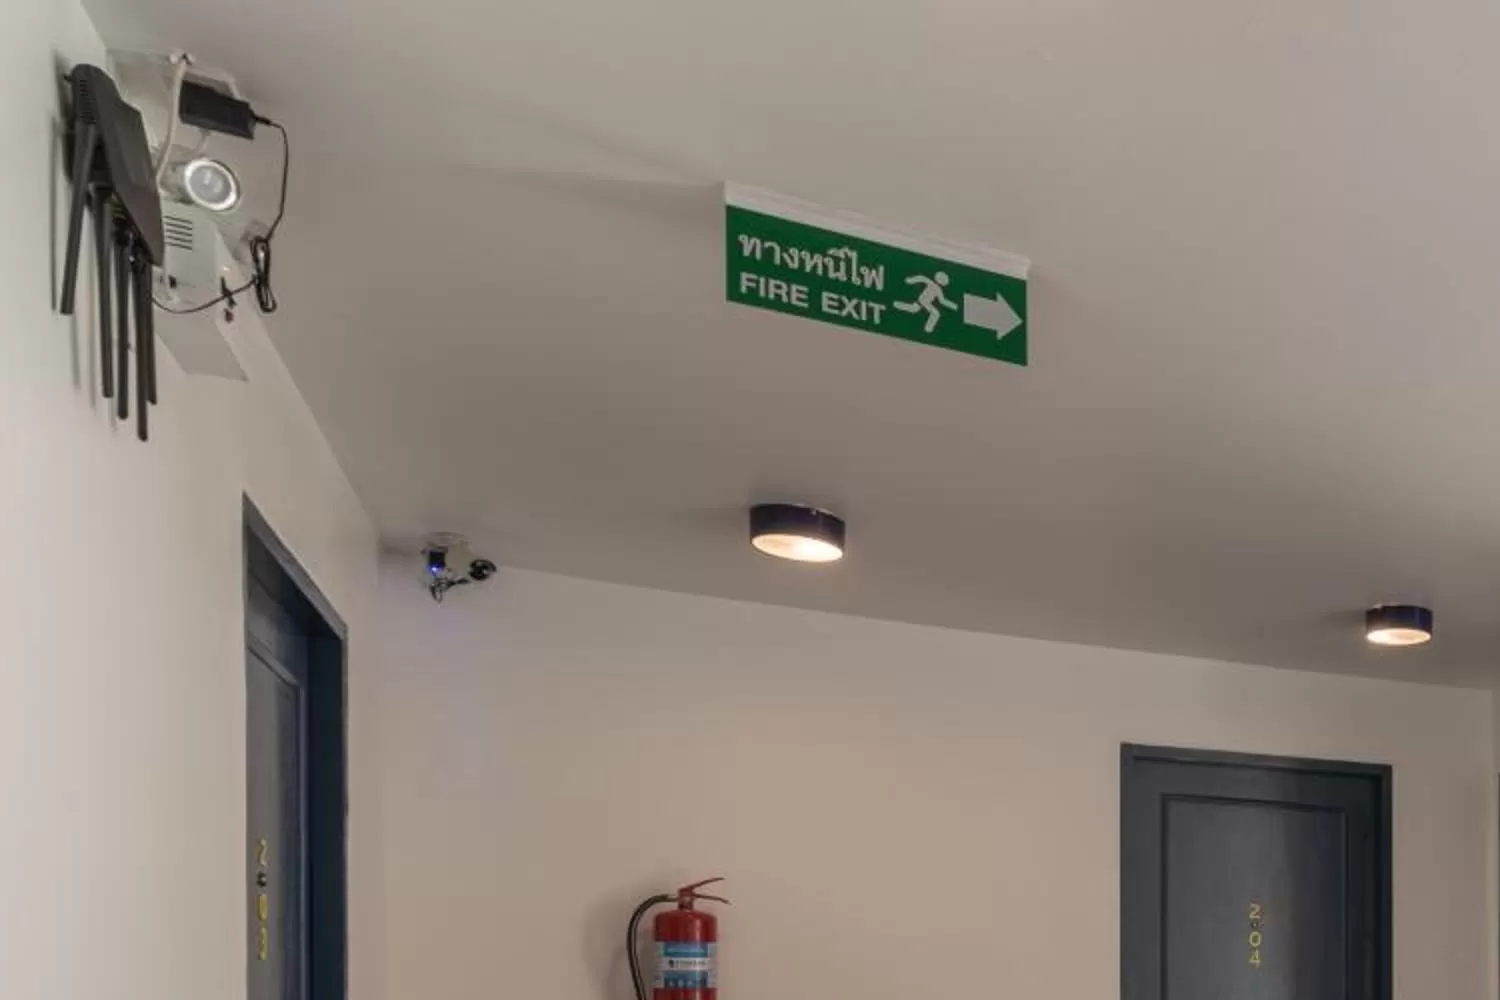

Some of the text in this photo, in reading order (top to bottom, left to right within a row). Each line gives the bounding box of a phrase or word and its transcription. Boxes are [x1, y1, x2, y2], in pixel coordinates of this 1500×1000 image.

[738, 233, 885, 291] ทางหนีไฟ
[739, 272, 886, 325] FIRE EXIT
[1248, 902, 1261, 969] 204
